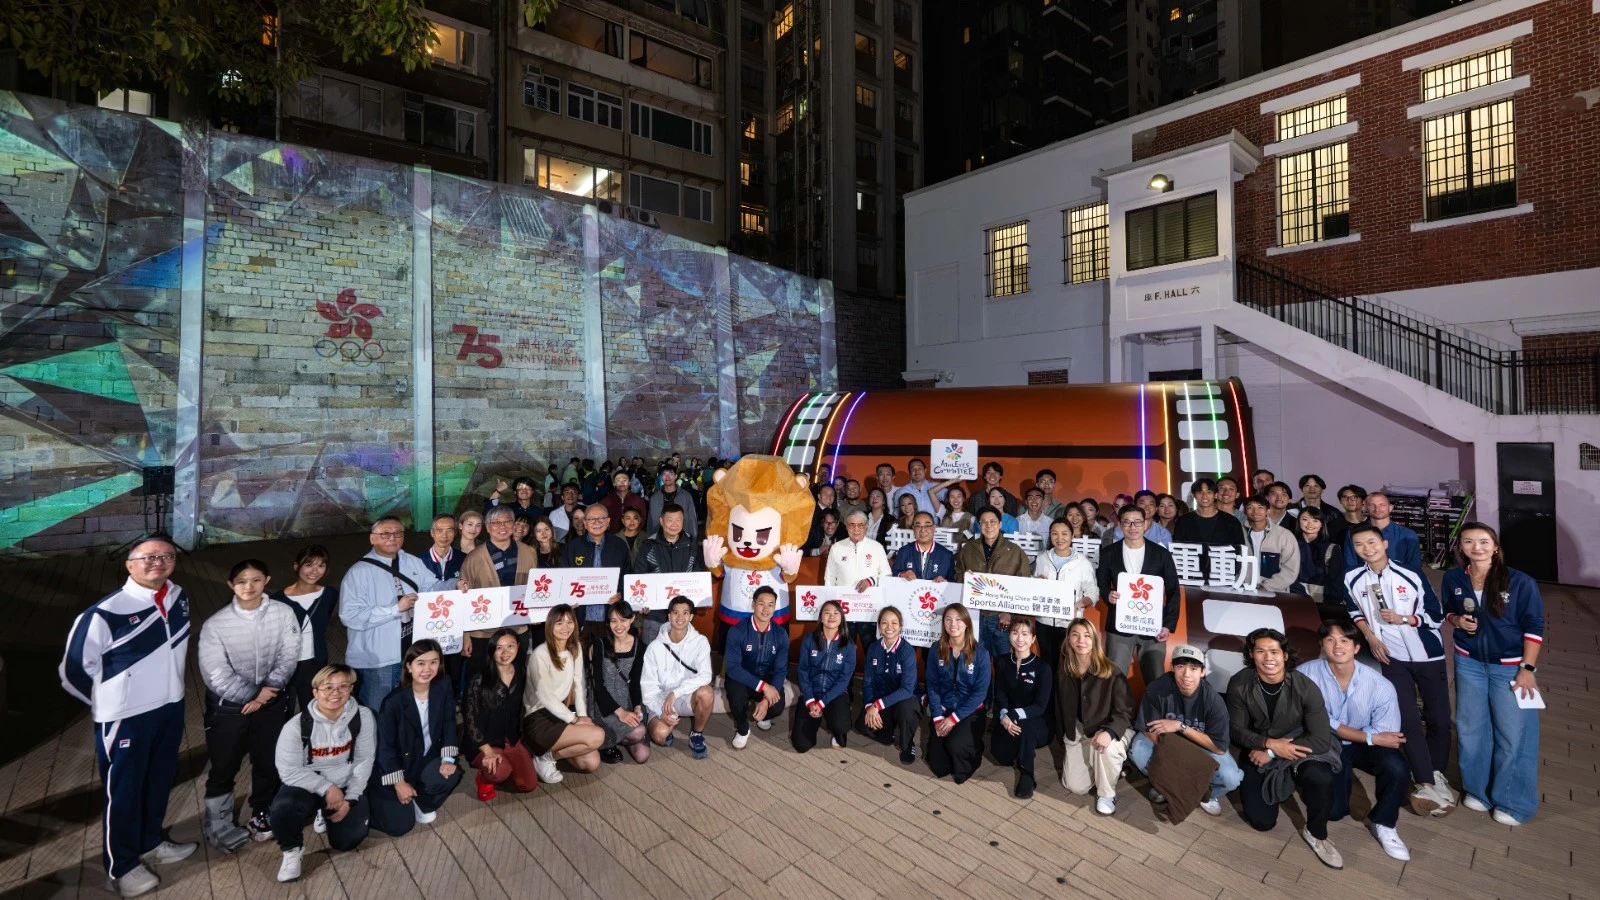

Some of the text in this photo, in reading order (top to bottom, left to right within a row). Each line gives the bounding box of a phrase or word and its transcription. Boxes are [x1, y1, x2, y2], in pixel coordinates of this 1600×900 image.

[1155, 292, 1162, 300] F.
[1164, 288, 1188, 299] HALL
[1191, 285, 1200, 294] 六
[452, 324, 502, 369] 75
[508, 354, 582, 366] ANNIVERSARY
[570, 582, 585, 598] 75
[985, 591, 999, 600] Hong
[1000, 593, 1013, 601] Kong
[969, 597, 996, 608] Sports
[997, 600, 1030, 612] Alliance
[1120, 622, 1158, 633] Sports Legacy
